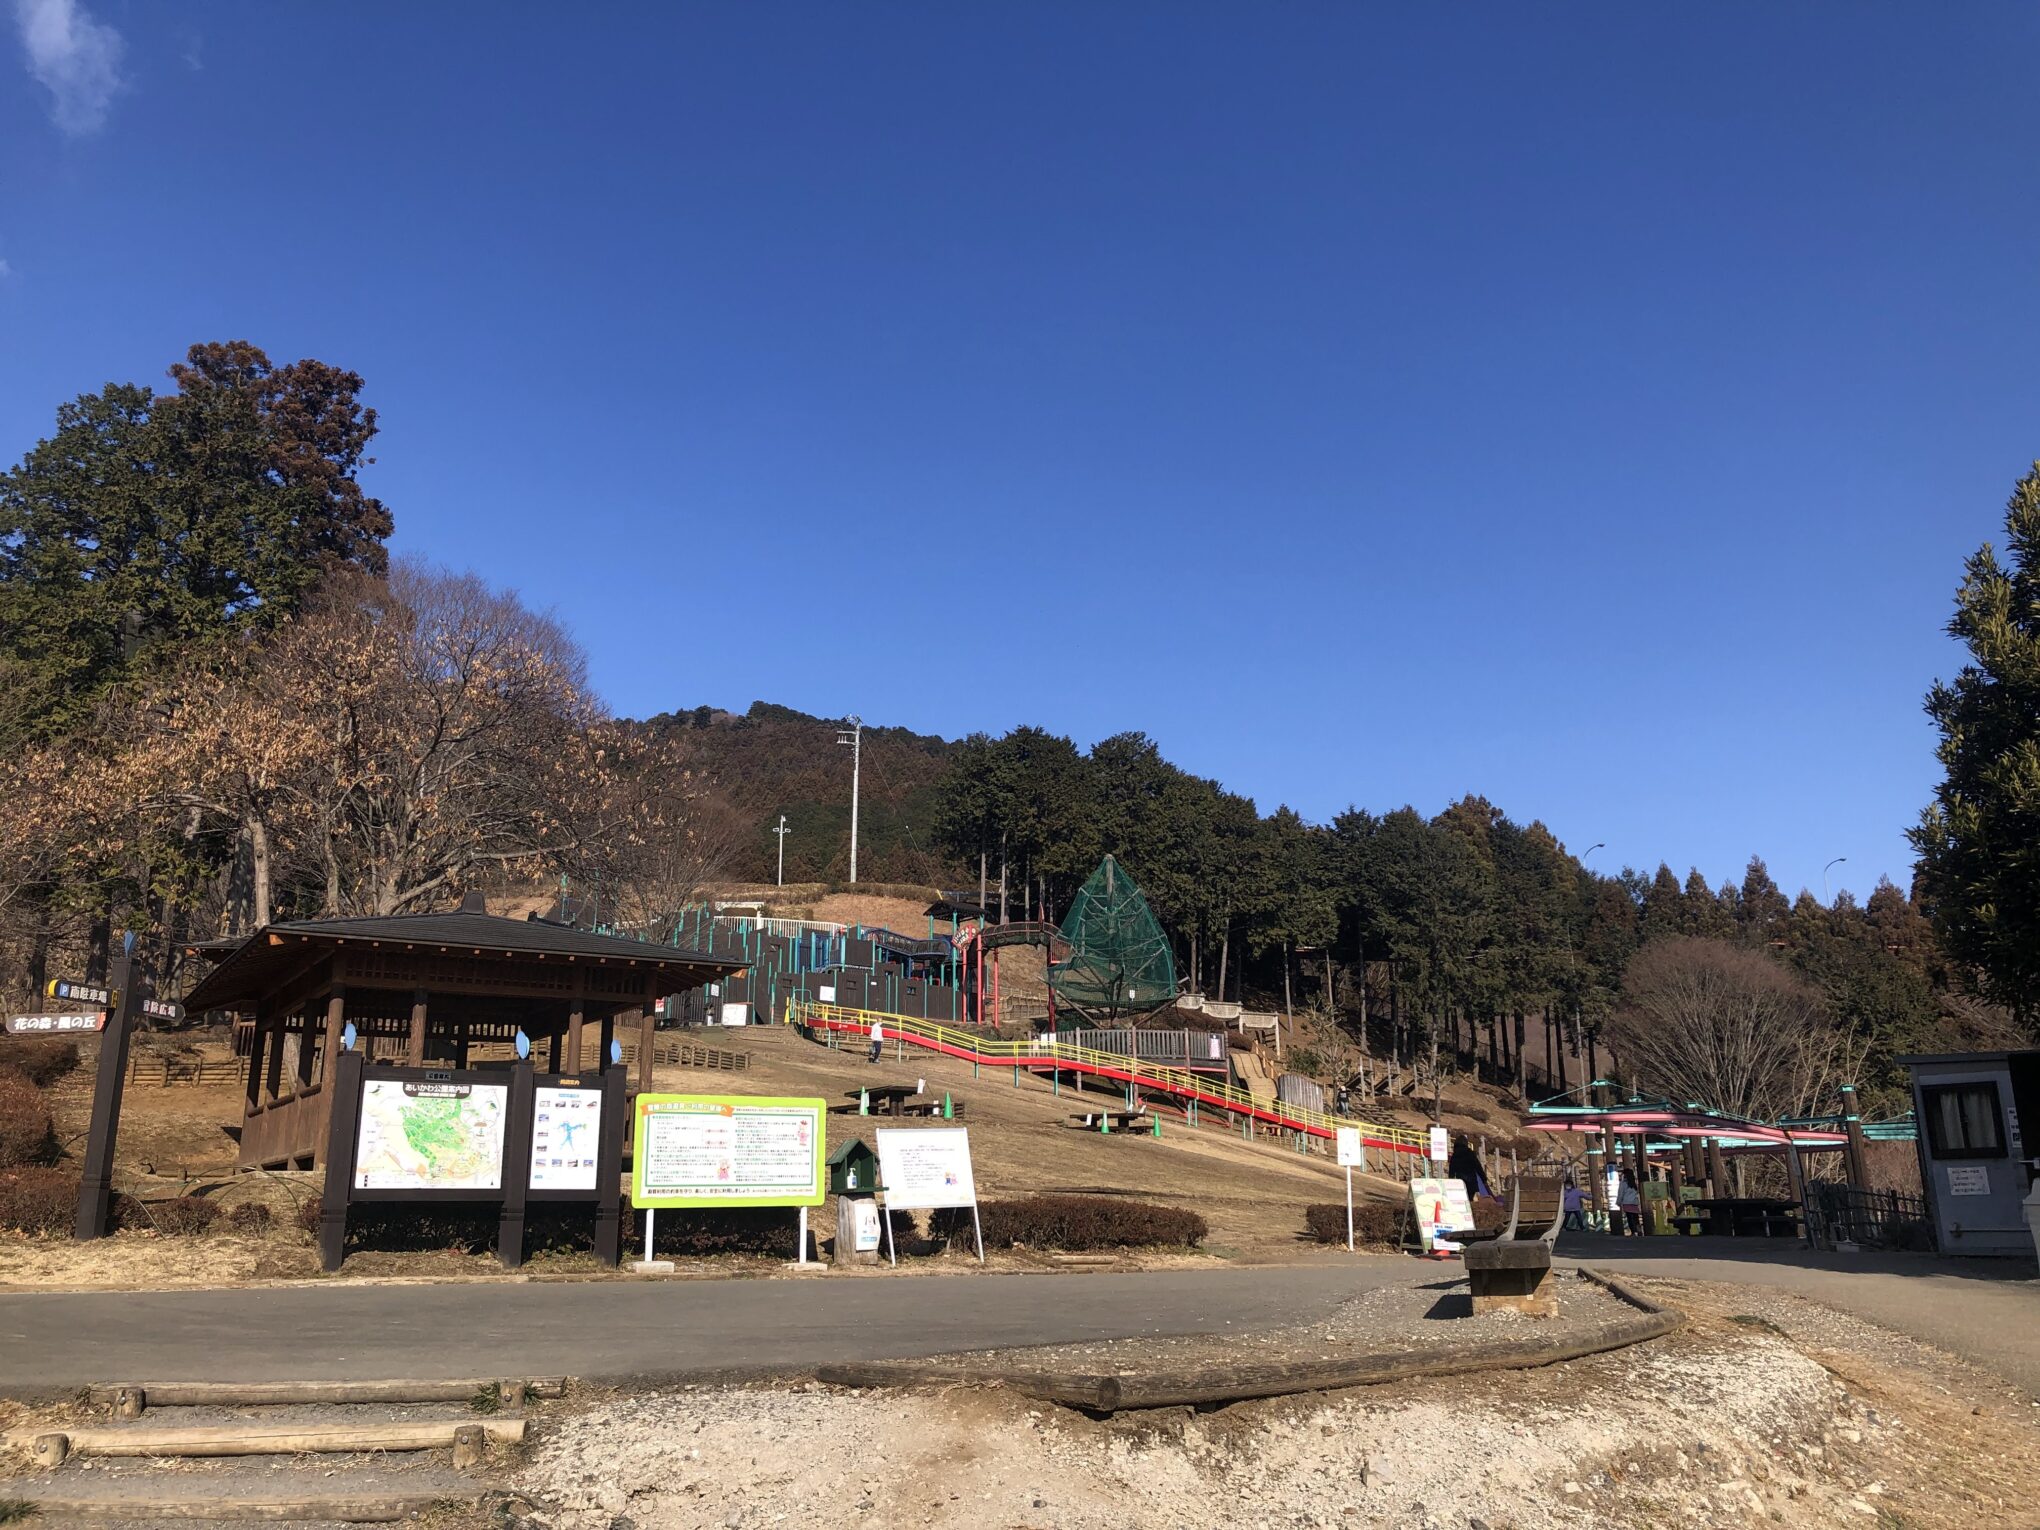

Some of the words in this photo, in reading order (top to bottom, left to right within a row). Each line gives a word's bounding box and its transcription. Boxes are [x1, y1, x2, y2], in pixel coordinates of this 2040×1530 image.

[70, 985, 108, 1004] 南駐車場
[14, 1016, 96, 1031] 花の森・風の丘
[405, 1083, 470, 1094] あいかわ公園案内図
